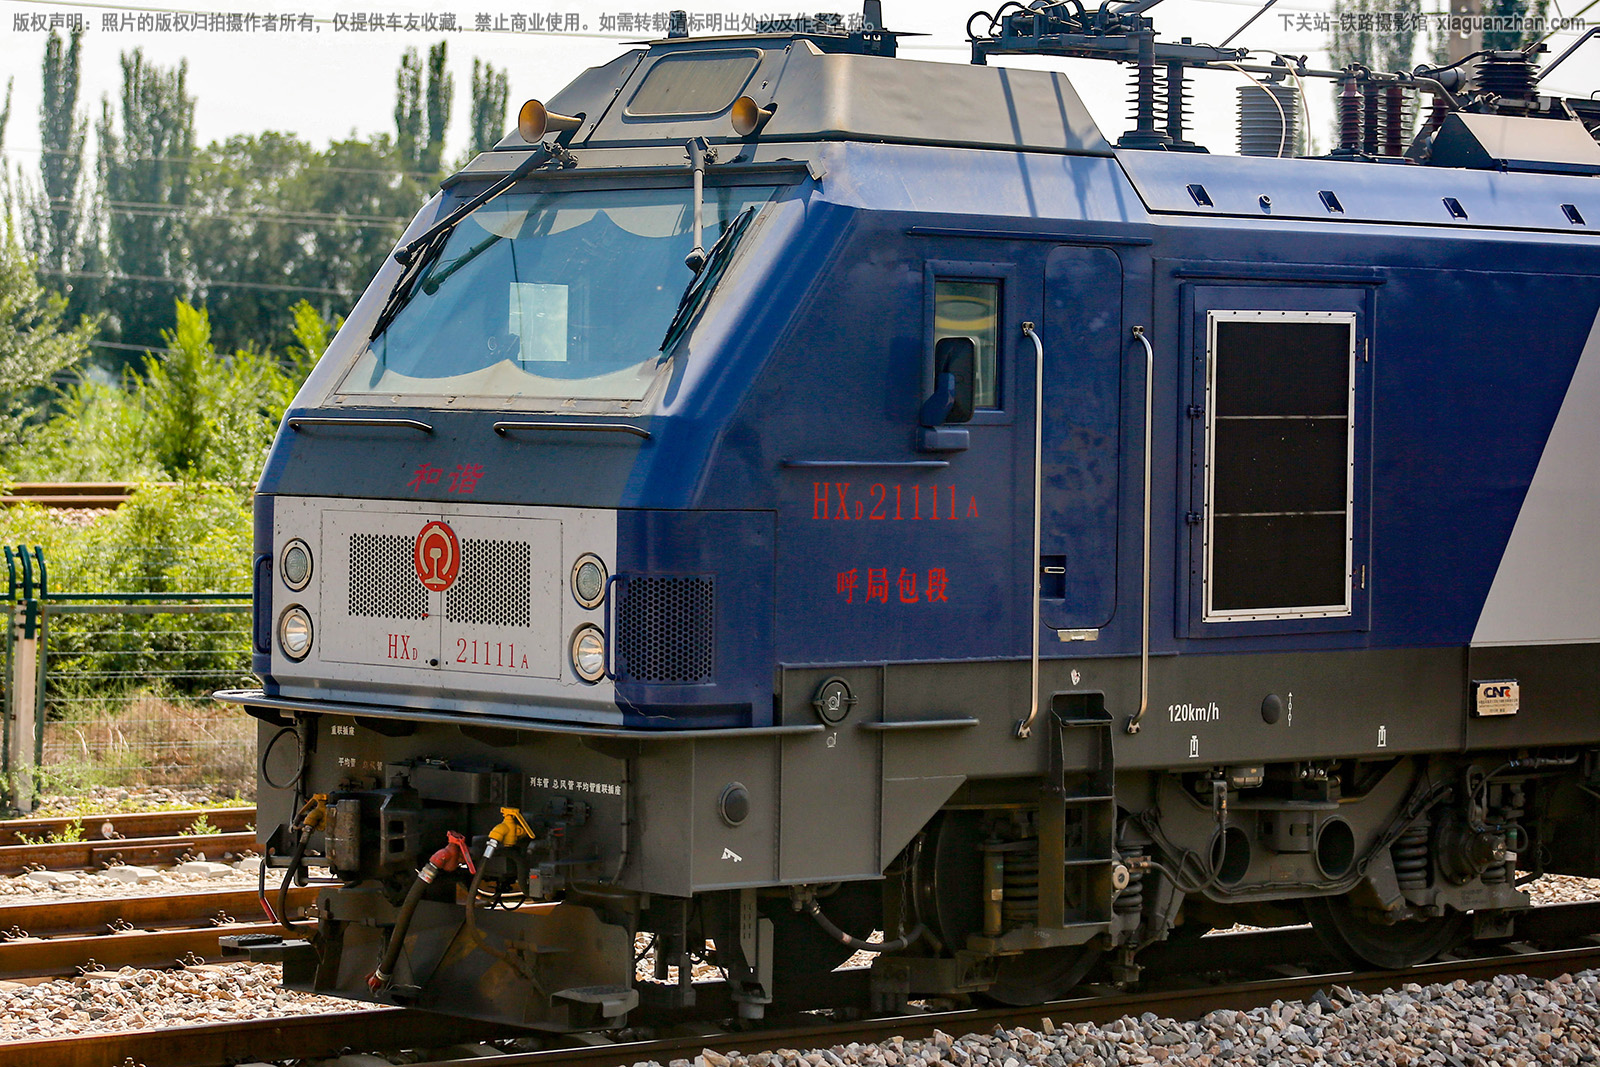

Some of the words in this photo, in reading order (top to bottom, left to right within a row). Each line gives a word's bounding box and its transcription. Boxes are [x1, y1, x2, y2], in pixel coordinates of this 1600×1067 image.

[406, 461, 486, 494] 和谐
[836, 567, 950, 604] 呼局包段
[387, 633, 418, 661] HXD
[456, 637, 529, 669] 21111A
[1483, 686, 1511, 698] CNR
[1168, 702, 1219, 722] 120km/h
[530, 776, 549, 789] 列车管
